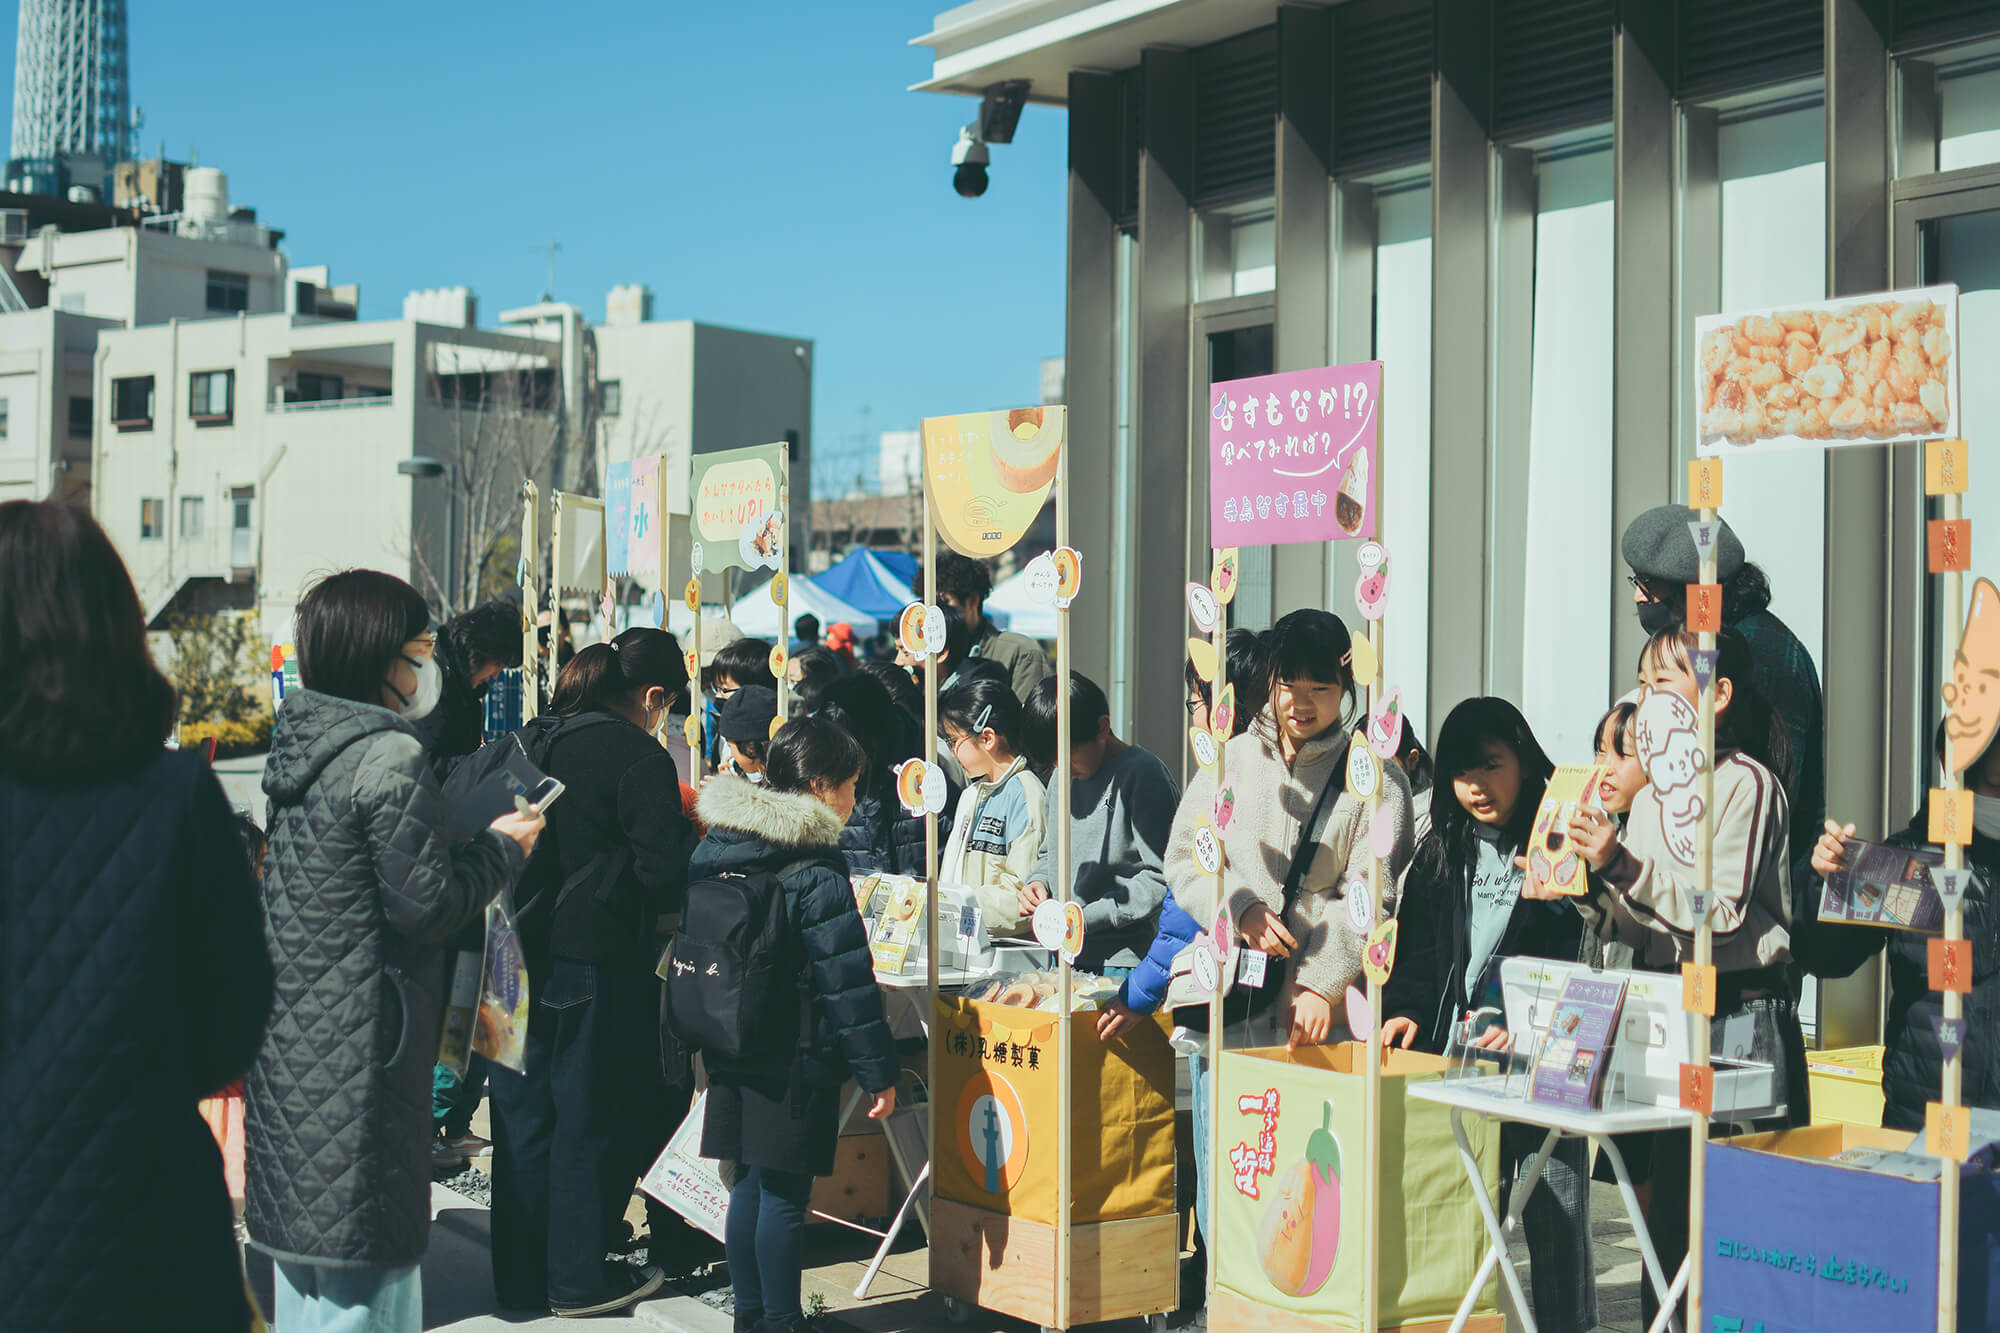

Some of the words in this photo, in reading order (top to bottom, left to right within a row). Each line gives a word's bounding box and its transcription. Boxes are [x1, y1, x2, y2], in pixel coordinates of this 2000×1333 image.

[1221, 432, 1331, 465] 食べてみれば?
[1223, 490, 1327, 523] 寺島なす最中
[1943, 875, 1958, 895] 豆
[1693, 895, 1704, 914] 豆
[946, 1029, 1041, 1071] (株)乳糖製菓
